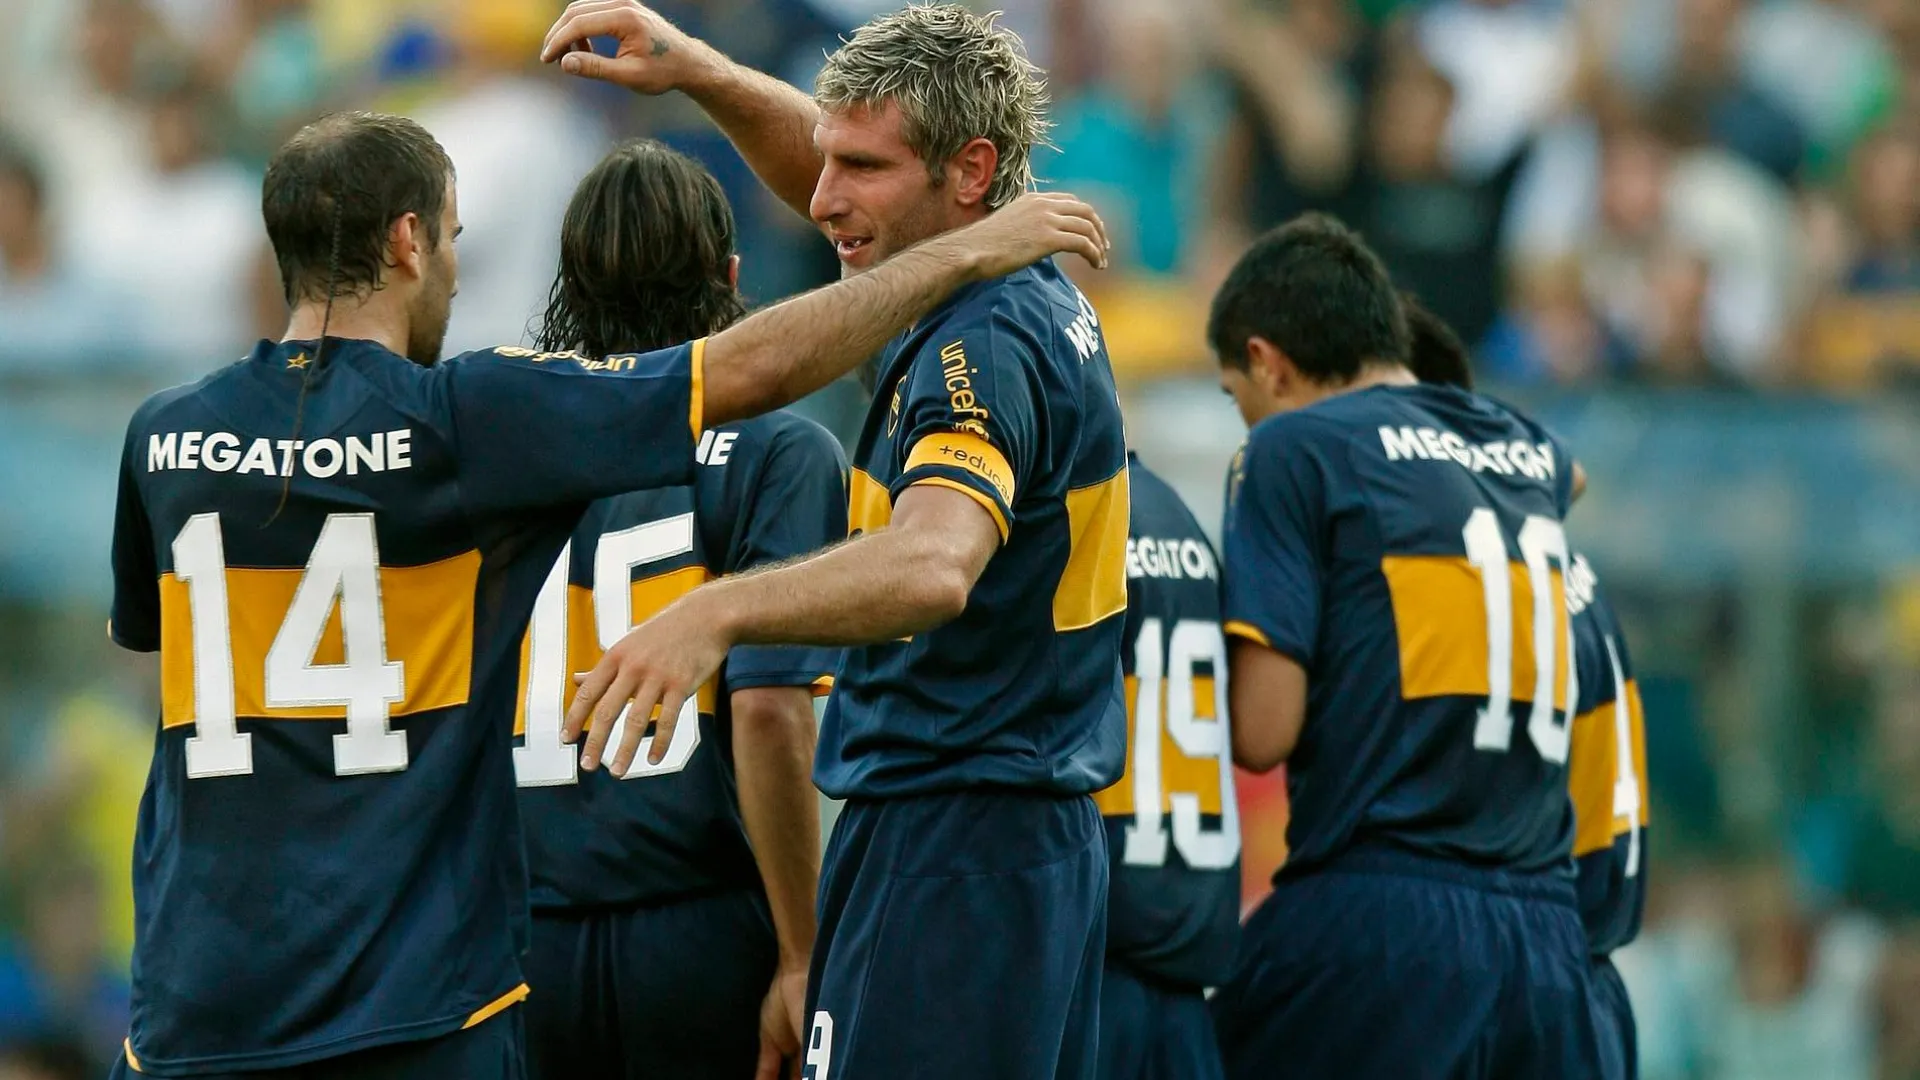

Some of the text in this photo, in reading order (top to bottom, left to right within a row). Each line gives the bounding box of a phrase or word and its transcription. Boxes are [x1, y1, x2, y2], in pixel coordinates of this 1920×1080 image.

[940, 339, 989, 420] unicef
[148, 429, 412, 478] MEGATONE
[1377, 425, 1557, 481] MEGATON
[172, 512, 409, 780] 14
[1462, 507, 1580, 765] 10
[1122, 618, 1242, 870] 19
[802, 1010, 834, 1080] 9
